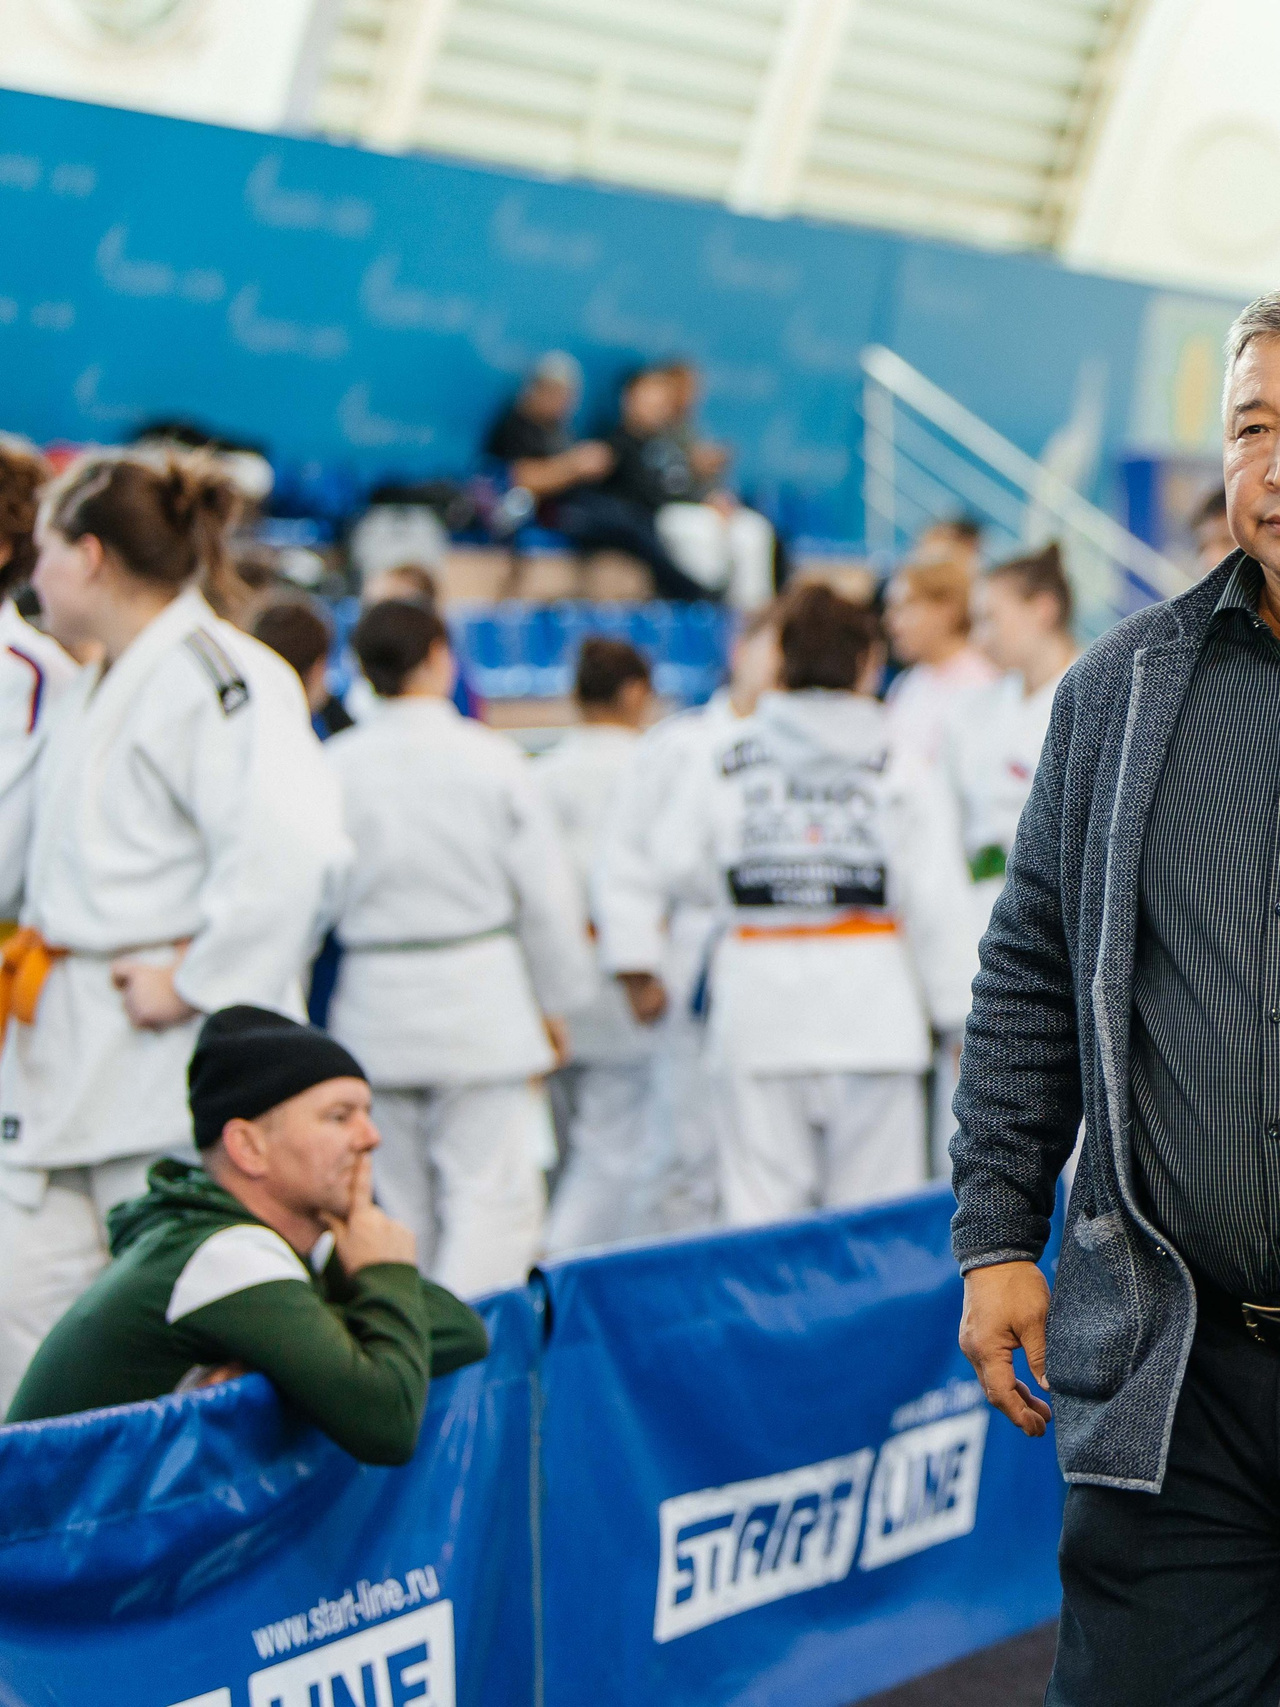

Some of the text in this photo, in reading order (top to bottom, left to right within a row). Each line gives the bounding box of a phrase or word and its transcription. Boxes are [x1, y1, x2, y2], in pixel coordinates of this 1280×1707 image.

[673, 1440, 970, 1610] START LINE
[251, 1564, 440, 1660] www.start-line.ru
